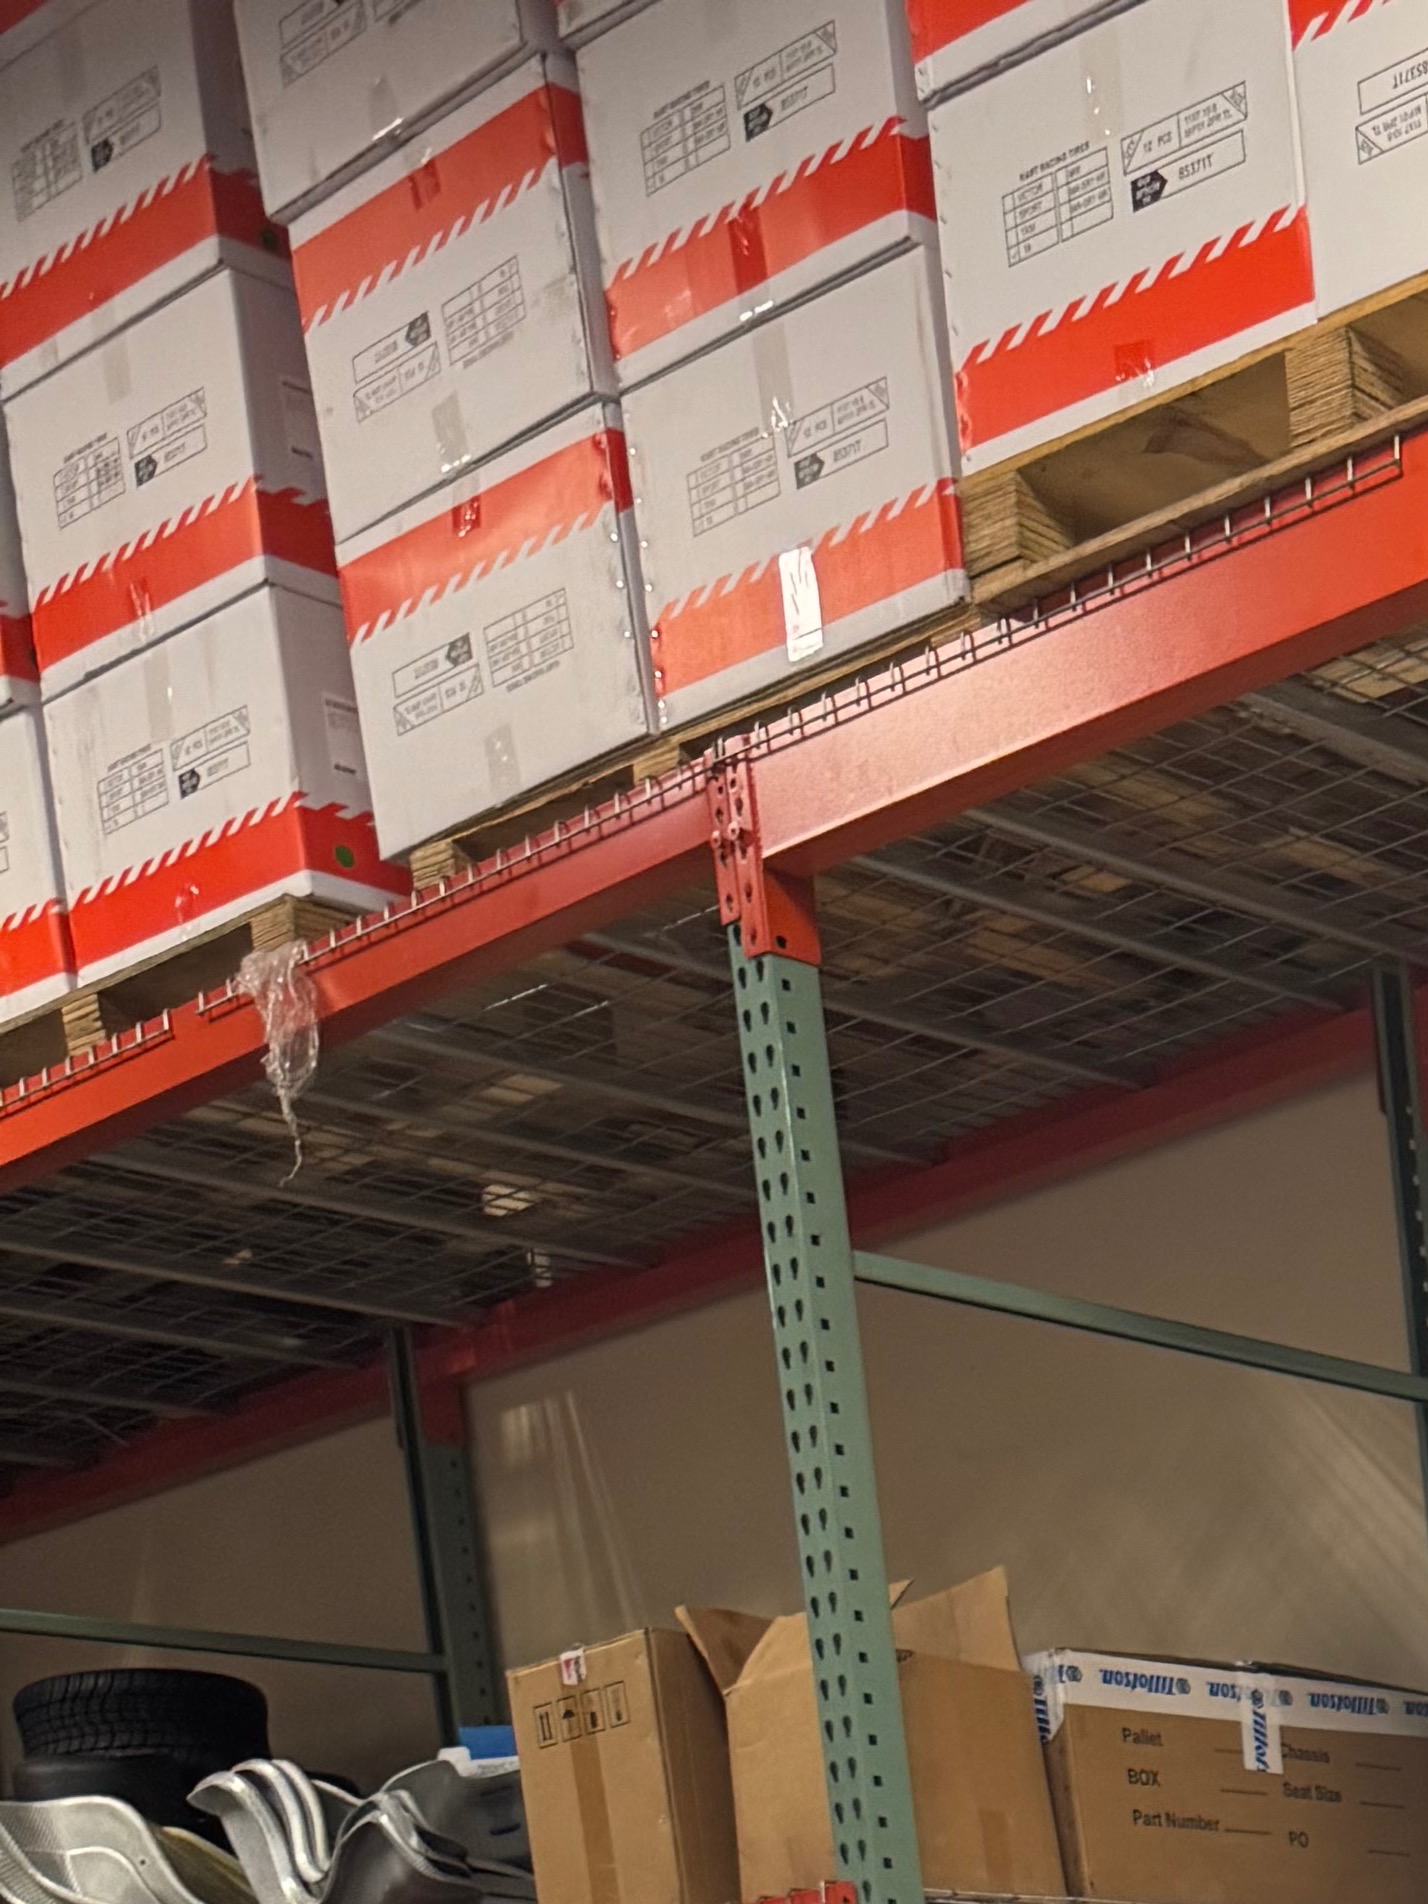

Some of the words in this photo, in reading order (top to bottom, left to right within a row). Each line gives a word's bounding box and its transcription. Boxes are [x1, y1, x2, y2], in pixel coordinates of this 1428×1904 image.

[1122, 1727, 1163, 1747] Pallet
[1128, 1768, 1161, 1787] BOX
[1282, 1783, 1313, 1800] Seat
[1315, 1786, 1343, 1803] Size
[1132, 1809, 1162, 1827] Part
[1166, 1813, 1221, 1832] Number
[1289, 1831, 1310, 1849] PO
